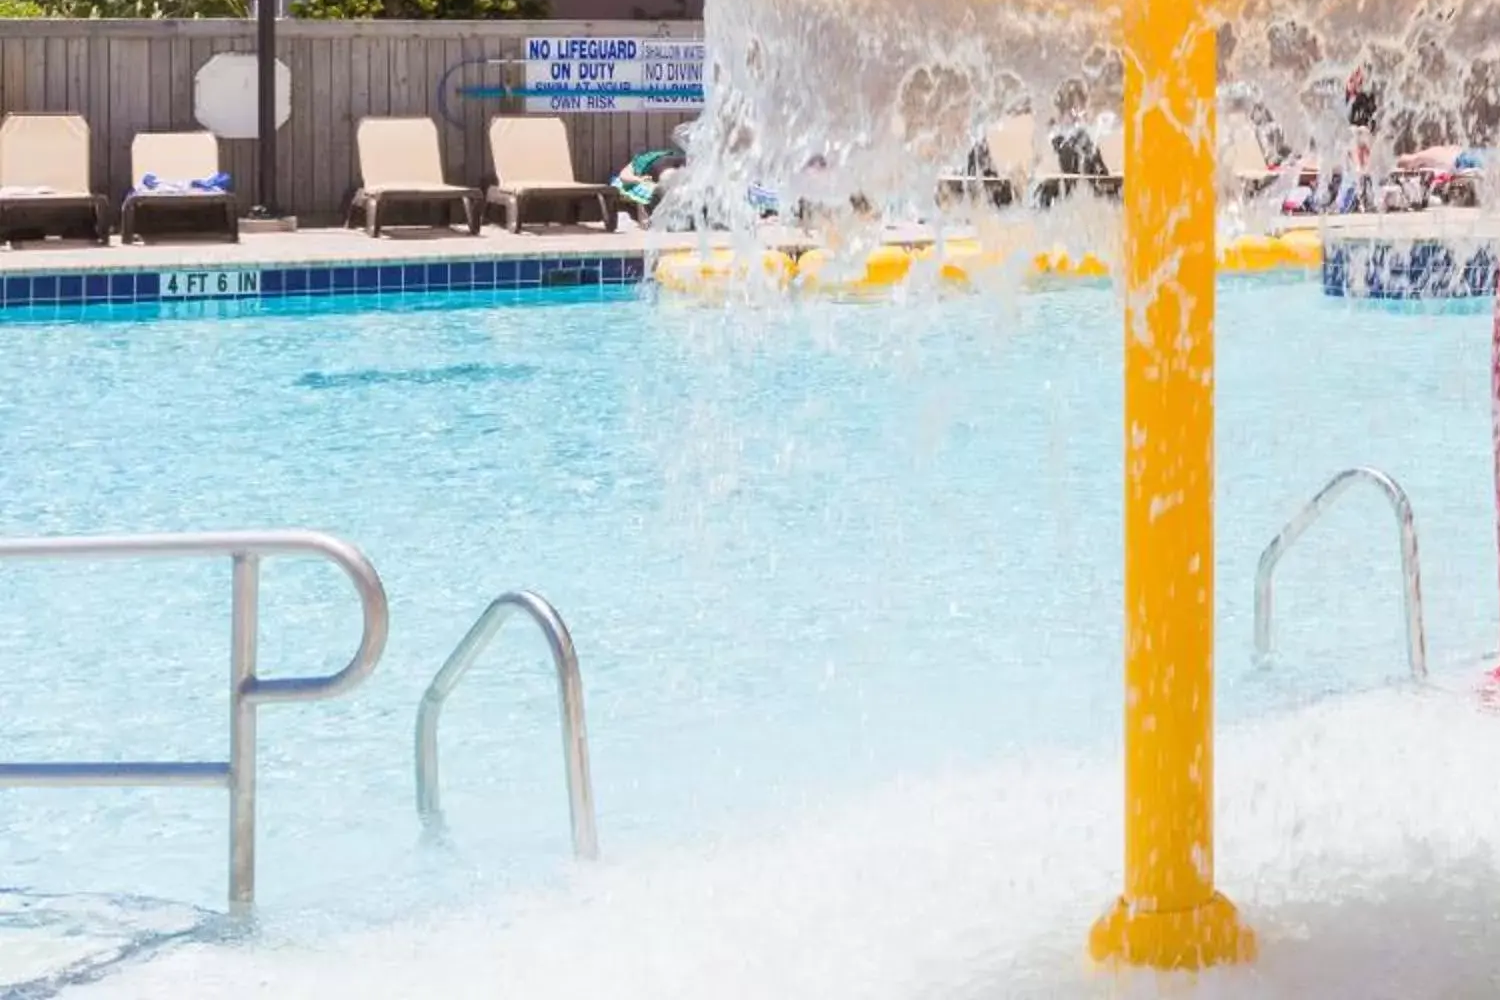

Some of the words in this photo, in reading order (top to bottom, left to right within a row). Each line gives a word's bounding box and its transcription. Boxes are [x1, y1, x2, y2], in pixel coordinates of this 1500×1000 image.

[529, 39, 550, 60] NO
[557, 39, 637, 60] LIFEGUARD
[683, 45, 705, 60] WATE
[551, 62, 571, 80] ON
[579, 62, 615, 80] DUTY
[645, 63, 663, 81] NO
[667, 63, 704, 81] DIVIN
[551, 95, 581, 110] OWN
[587, 95, 616, 110] RISK
[167, 273, 179, 294] 4
[187, 273, 209, 293] FT
[217, 272, 229, 293] 6
[237, 272, 257, 292] IN
